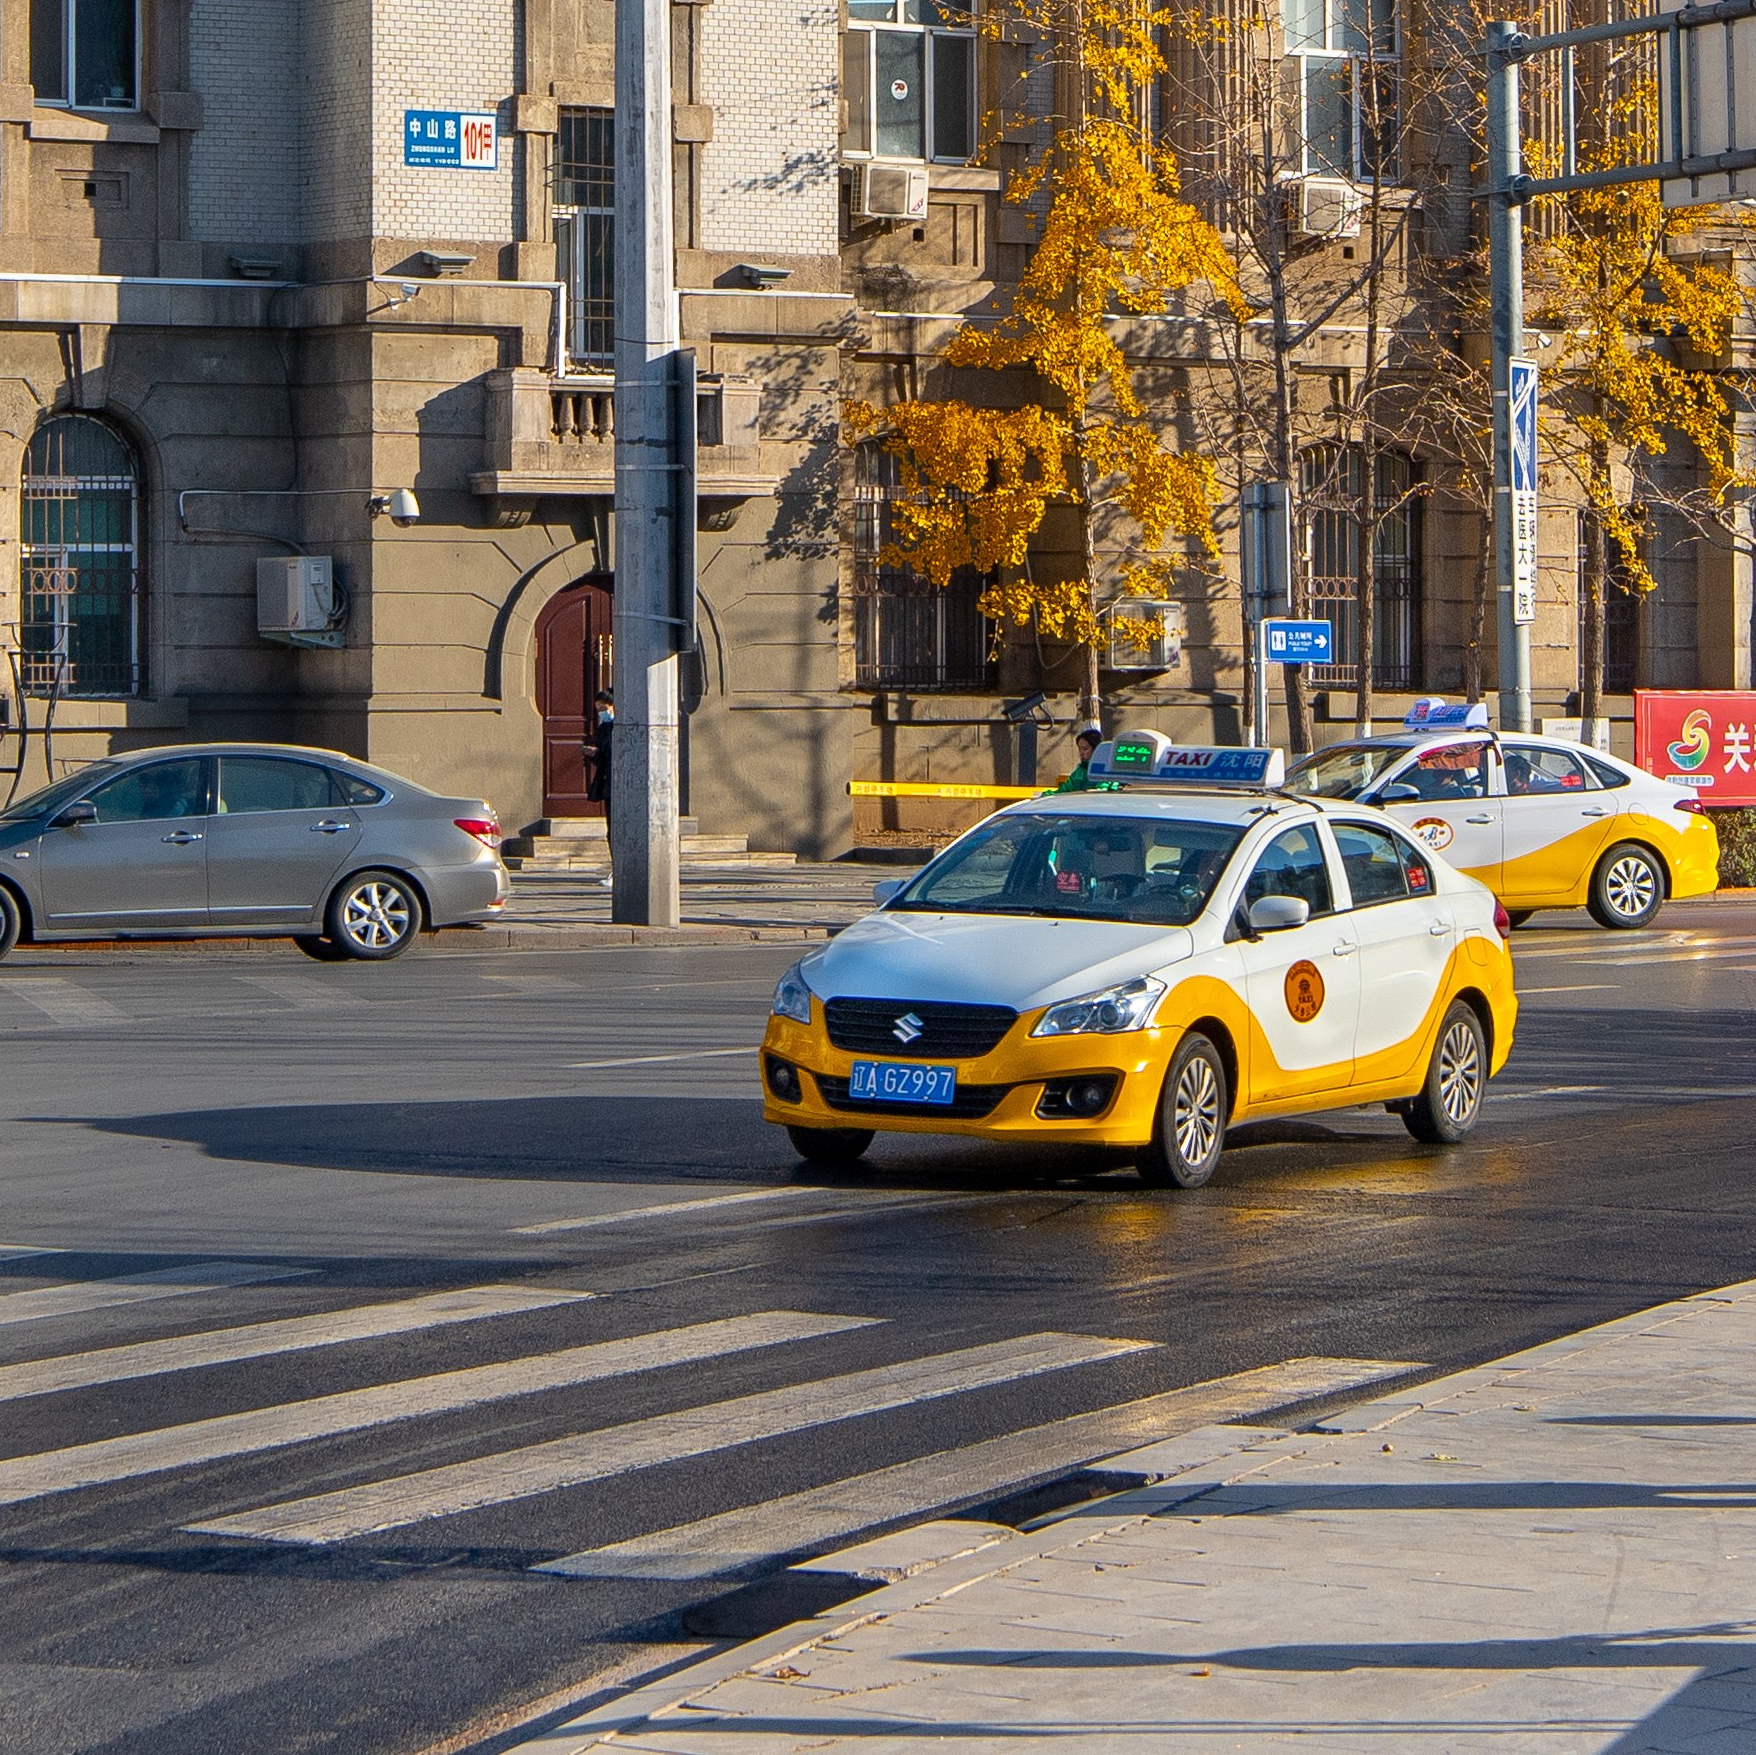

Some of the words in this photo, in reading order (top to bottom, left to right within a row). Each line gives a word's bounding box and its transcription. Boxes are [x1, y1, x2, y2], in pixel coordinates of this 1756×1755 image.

[409, 117, 457, 140] 中山路
[1165, 751, 1213, 766] TAXI
[1220, 753, 1265, 768] 沈阳
